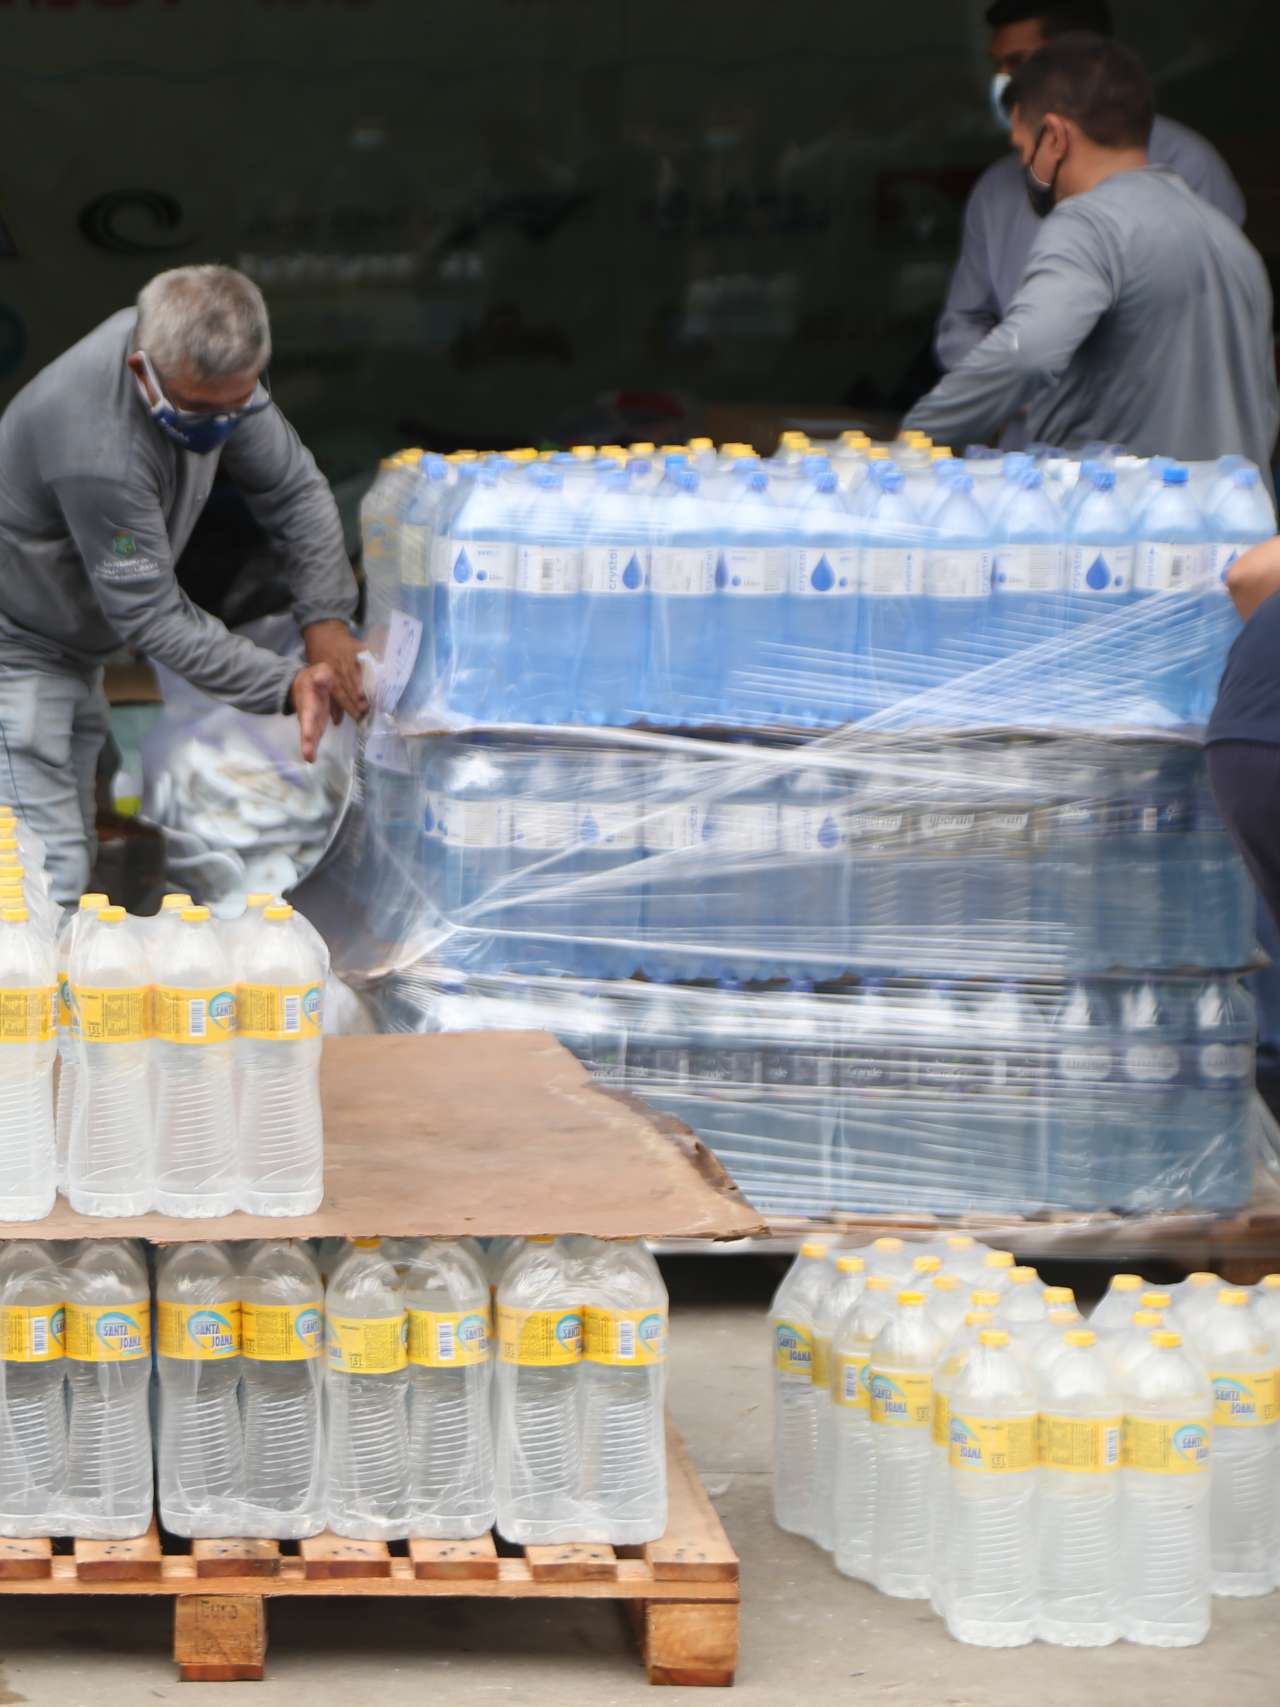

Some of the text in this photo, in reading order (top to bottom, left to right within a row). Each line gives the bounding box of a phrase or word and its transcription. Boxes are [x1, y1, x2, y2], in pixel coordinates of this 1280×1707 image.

[104, 1325, 128, 1336] SANTA
[195, 1322, 219, 1335] SANTA
[121, 1336, 140, 1348] JOANA
[212, 1335, 232, 1347] JOANA
